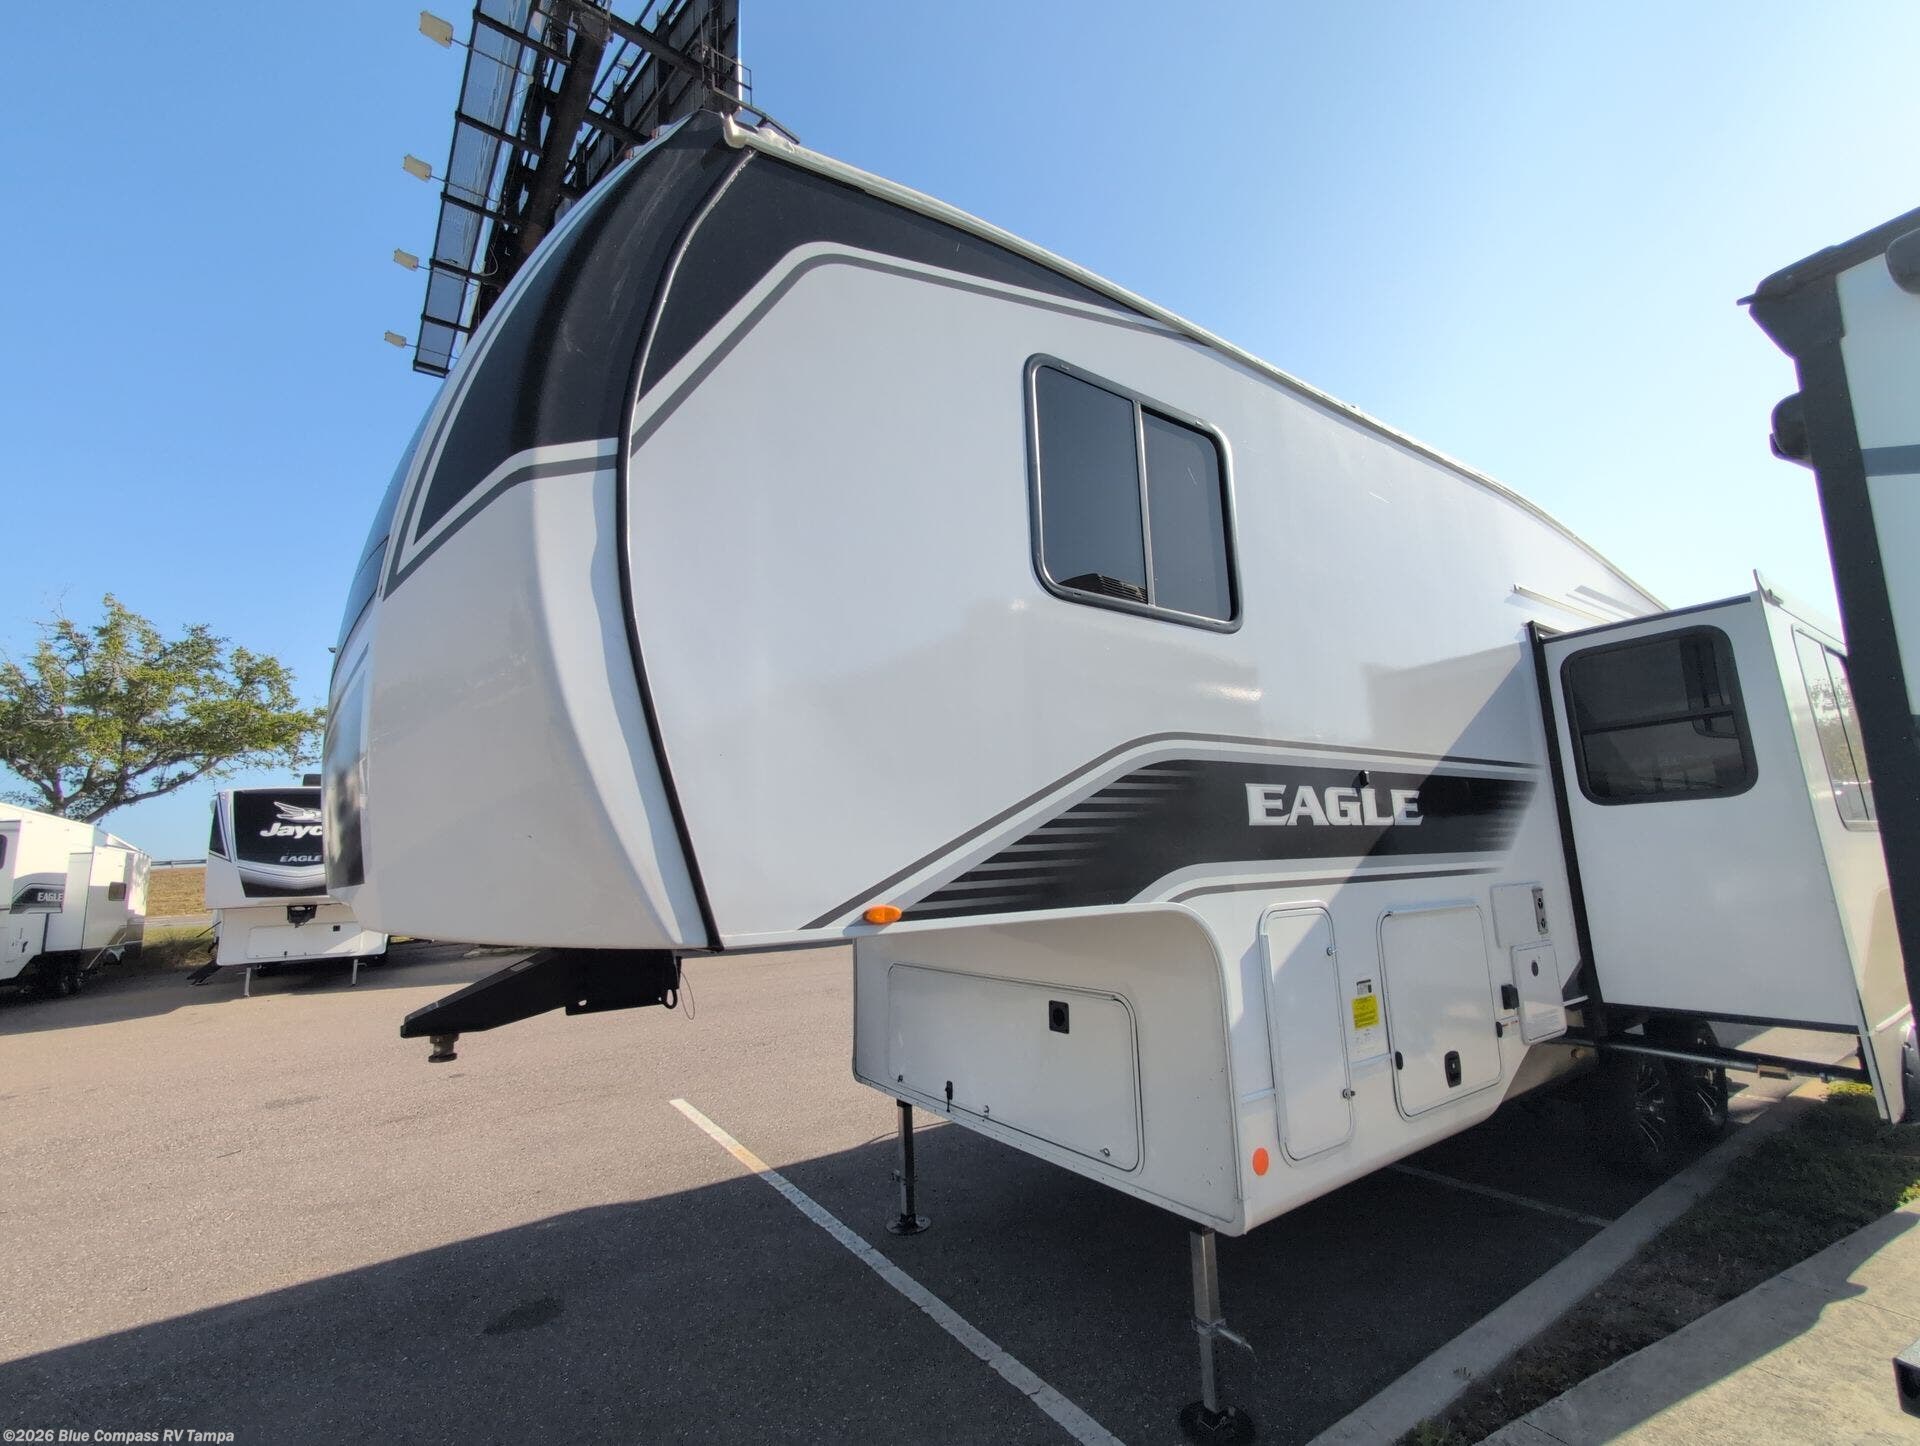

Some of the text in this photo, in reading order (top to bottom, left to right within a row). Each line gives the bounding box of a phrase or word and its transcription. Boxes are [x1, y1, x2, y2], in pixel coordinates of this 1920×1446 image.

[1245, 783, 1424, 826] EAGLE
[260, 822, 323, 839] Jayc
[280, 855, 322, 863] EAGLE
[37, 892, 64, 901] EAGLE
